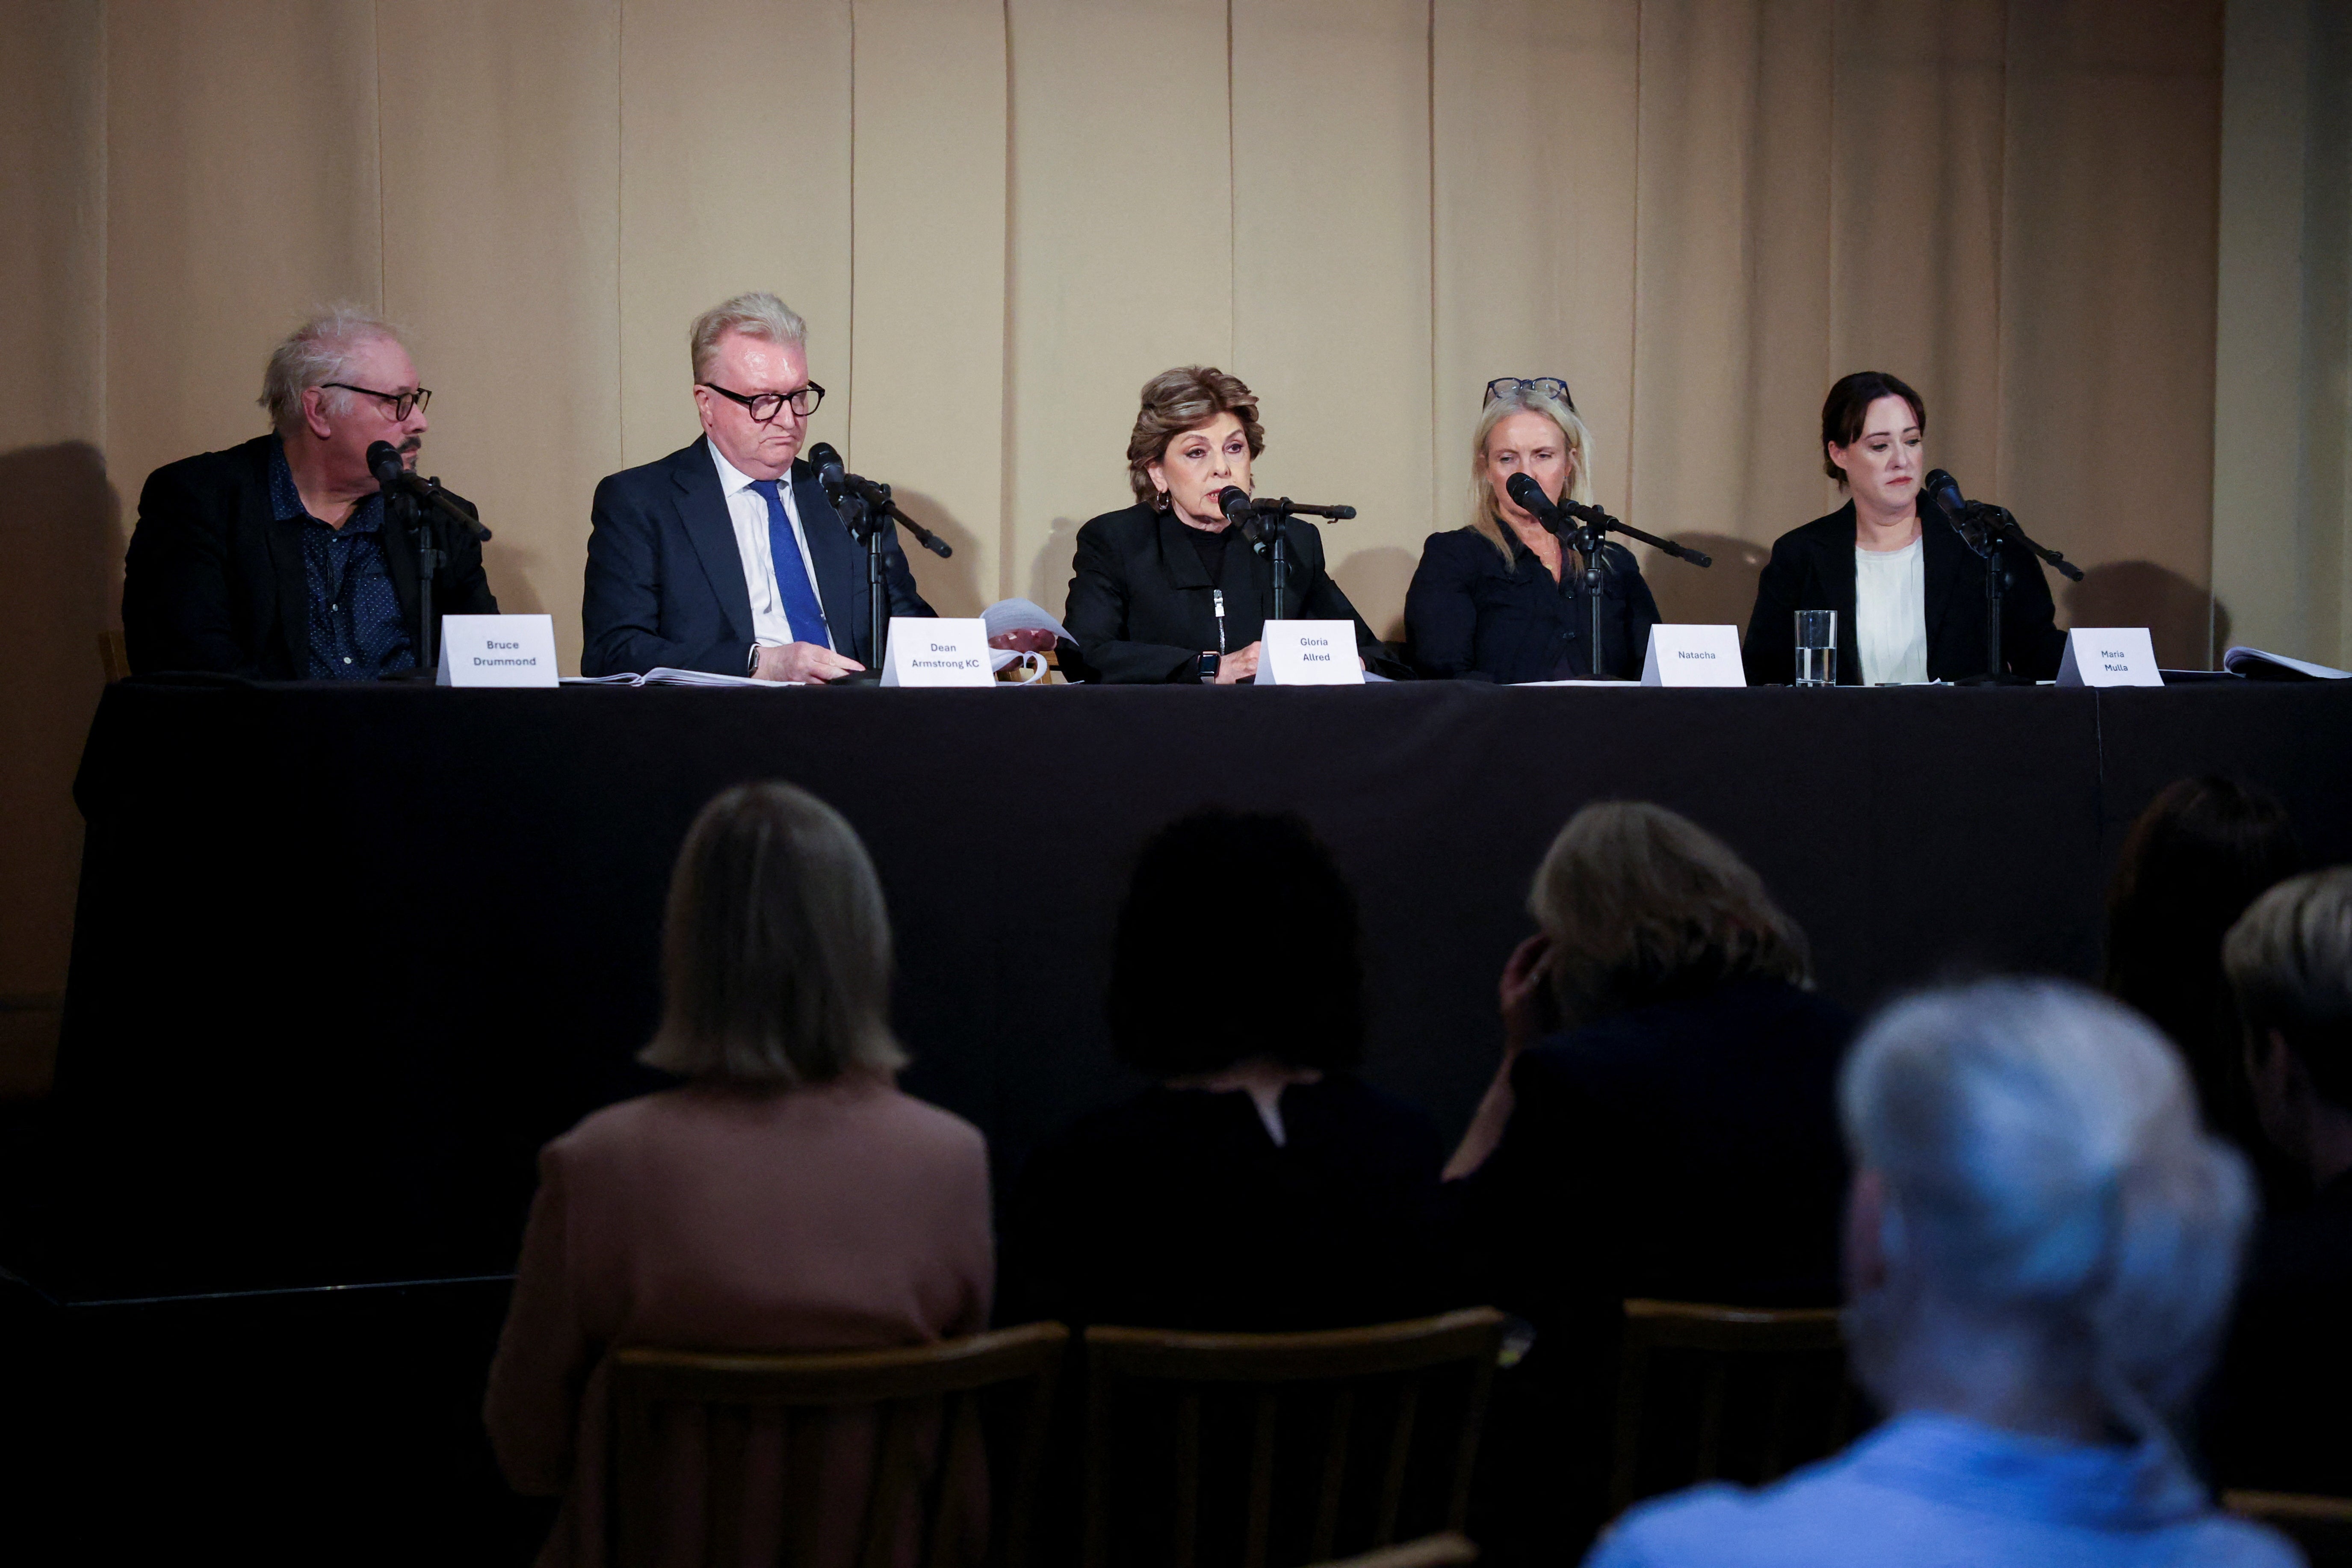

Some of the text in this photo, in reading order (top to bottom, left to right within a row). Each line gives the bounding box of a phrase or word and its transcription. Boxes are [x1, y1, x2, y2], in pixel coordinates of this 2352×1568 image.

[487, 641, 519, 650] Bruce
[1300, 638, 1328, 646] Gloria
[931, 643, 956, 652] Dean
[473, 657, 536, 666] Drummond
[912, 659, 979, 669] Armstrong KC
